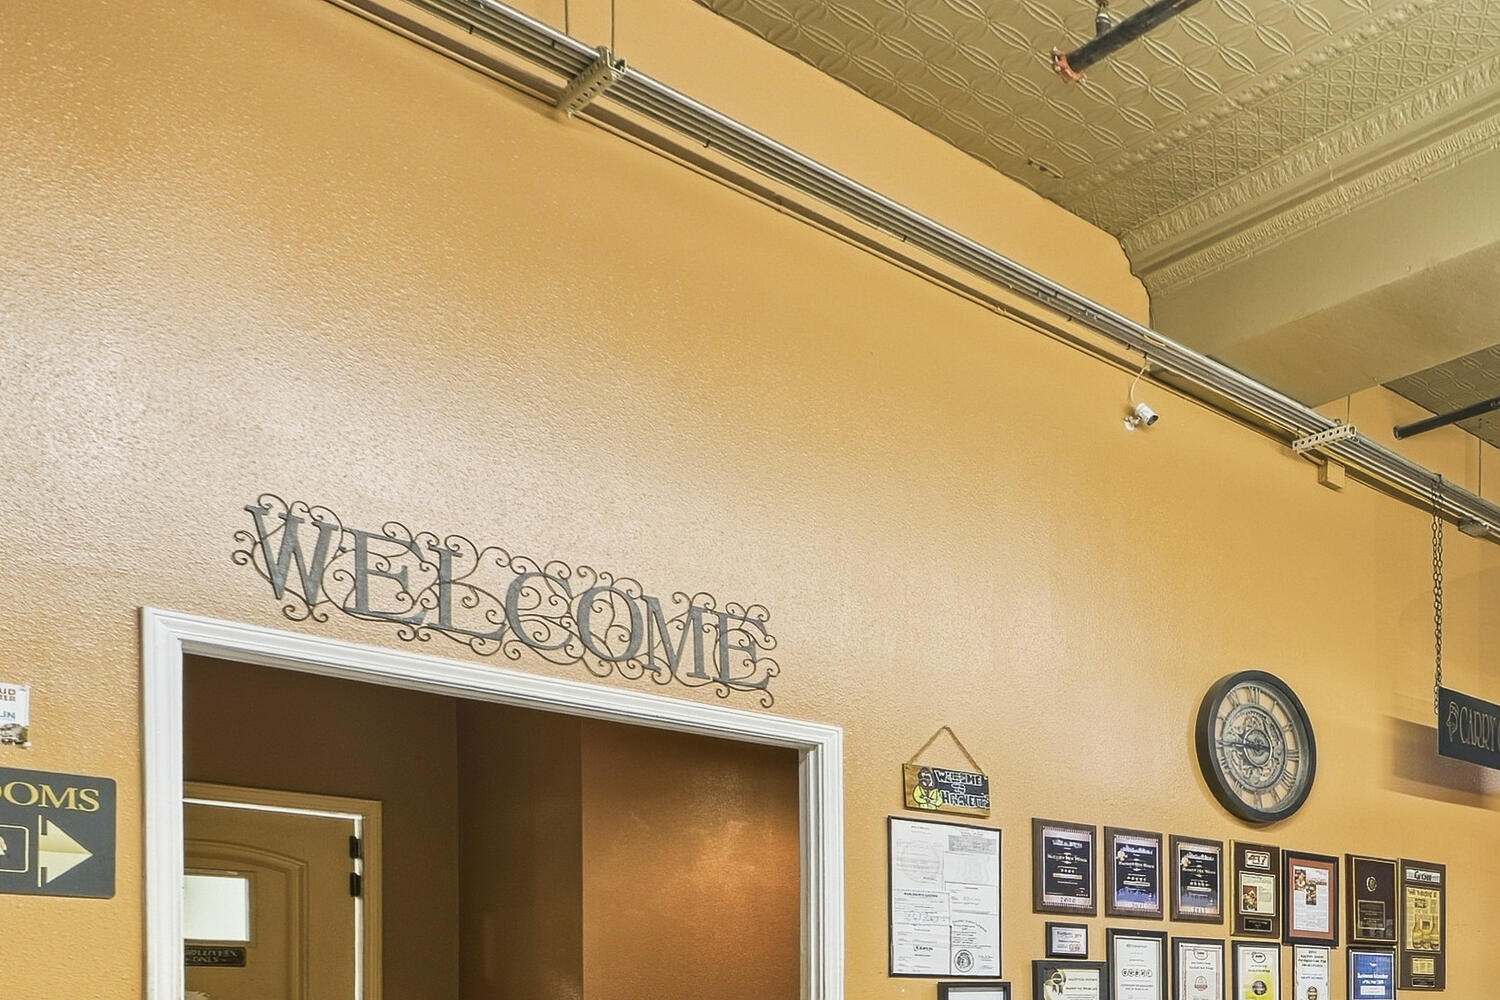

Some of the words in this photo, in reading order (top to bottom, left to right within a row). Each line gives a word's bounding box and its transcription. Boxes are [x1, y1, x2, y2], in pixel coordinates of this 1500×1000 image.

[242, 503, 773, 692] WELCOME
[1460, 706, 1496, 752] CARRY
[0, 781, 100, 812] OMS
